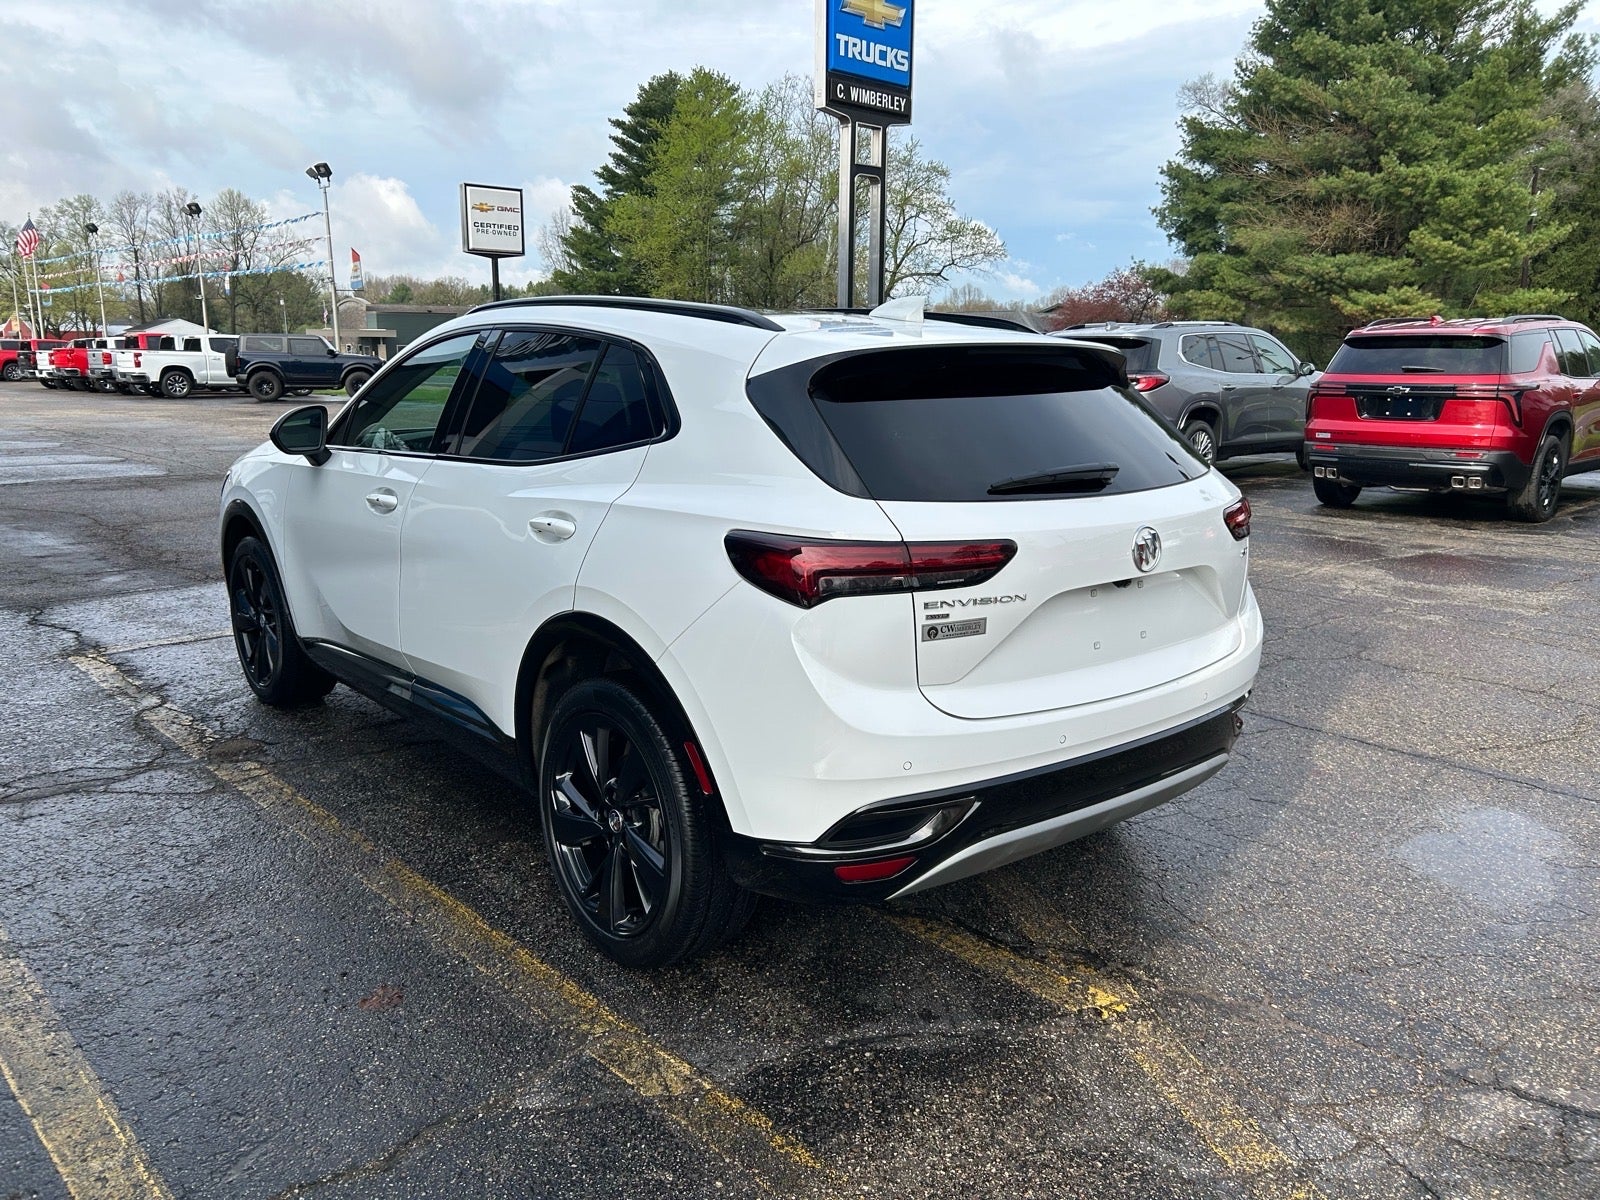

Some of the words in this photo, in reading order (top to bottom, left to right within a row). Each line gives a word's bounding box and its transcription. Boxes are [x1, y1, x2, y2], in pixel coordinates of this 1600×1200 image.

[836, 33, 909, 72] TRUCKS
[837, 83, 846, 100] C.
[850, 86, 907, 112] WIMBERLEY
[496, 205, 521, 214] GMC
[473, 221, 520, 231] CERTIFIED
[476, 228, 517, 237] PRE-OWNED
[923, 593, 1027, 610] ENVISION
